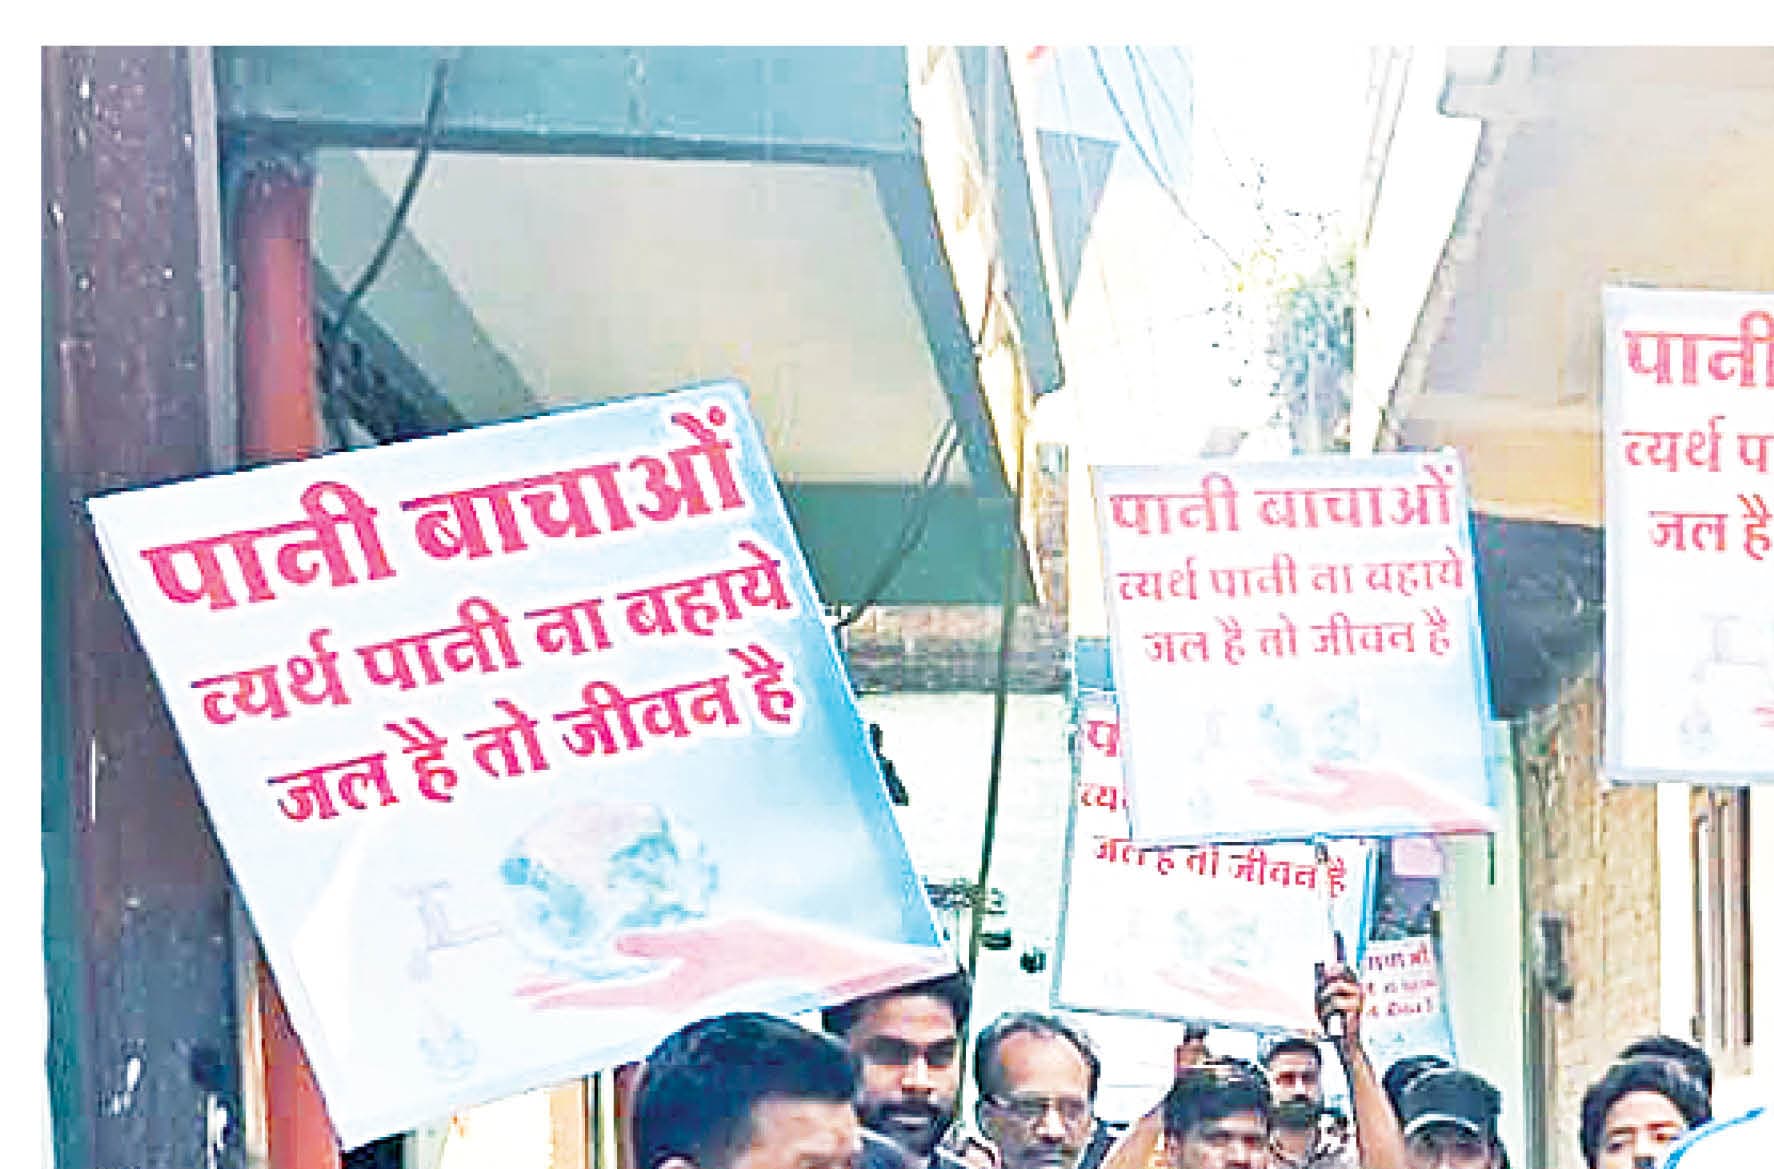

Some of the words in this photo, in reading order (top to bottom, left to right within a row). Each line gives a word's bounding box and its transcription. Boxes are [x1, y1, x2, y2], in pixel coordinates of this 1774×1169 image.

[138, 480, 398, 612] पानी
[400, 405, 746, 562] बाचाओं
[1110, 471, 1240, 536] पानी
[1649, 511, 1729, 552] जल
[1738, 493, 1774, 561] है
[1210, 552, 1298, 597] पानी
[1311, 564, 1353, 595] ना
[354, 596, 524, 694] पानी
[524, 598, 614, 658] ना
[1143, 631, 1210, 664] जल
[1216, 615, 1245, 666] है
[1258, 613, 1298, 657] तो
[1310, 610, 1416, 656] जीवन
[1422, 606, 1452, 657] है
[267, 750, 401, 823] जल
[383, 716, 460, 804] है
[465, 697, 550, 779] तो
[551, 675, 741, 760] जीवन
[728, 643, 797, 725] है
